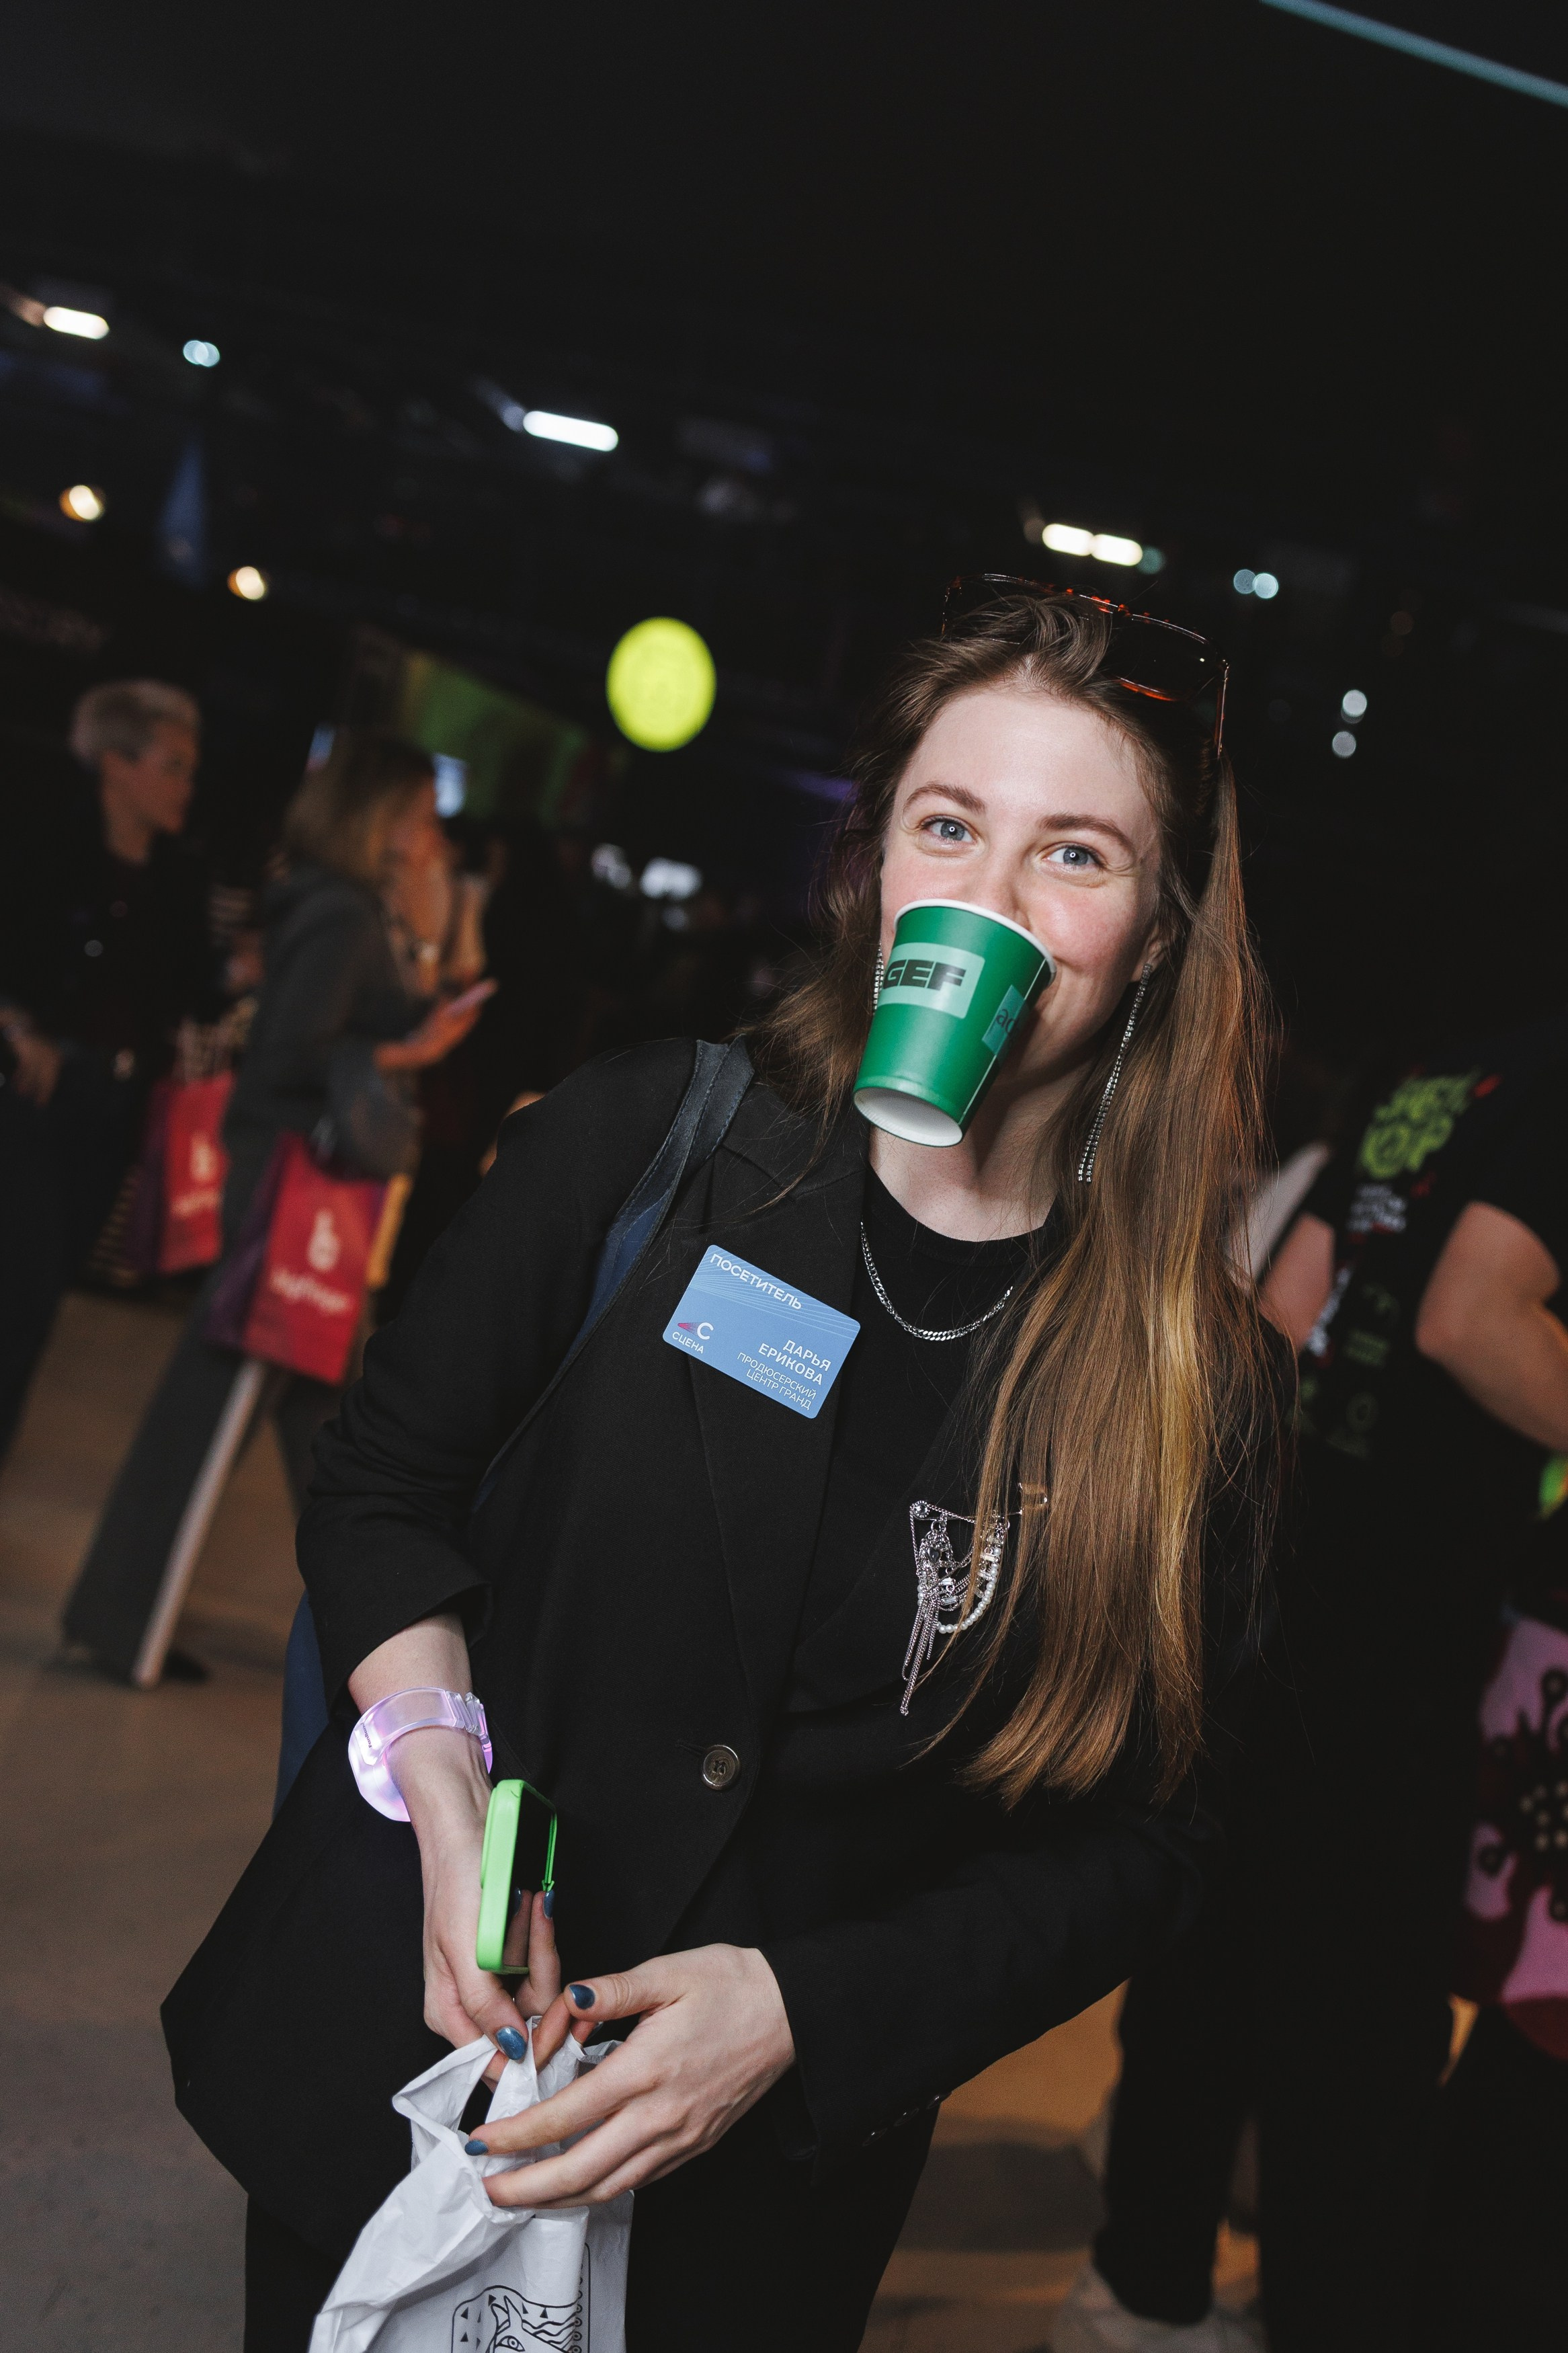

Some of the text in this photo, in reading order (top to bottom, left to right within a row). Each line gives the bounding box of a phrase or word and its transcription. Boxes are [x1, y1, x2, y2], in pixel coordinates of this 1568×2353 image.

[710, 1253, 802, 1310] ПОСЕТИТЕЛЬ
[672, 1332, 704, 1354] СЦЕНА
[783, 1339, 831, 1371] ДАРЬЯ
[737, 1352, 817, 1400] ПРОДЮСЕРСКИЙ
[758, 1343, 823, 1385] ЕРИКОВА
[747, 1369, 812, 1410] ЦЕНТР ГРАНД
